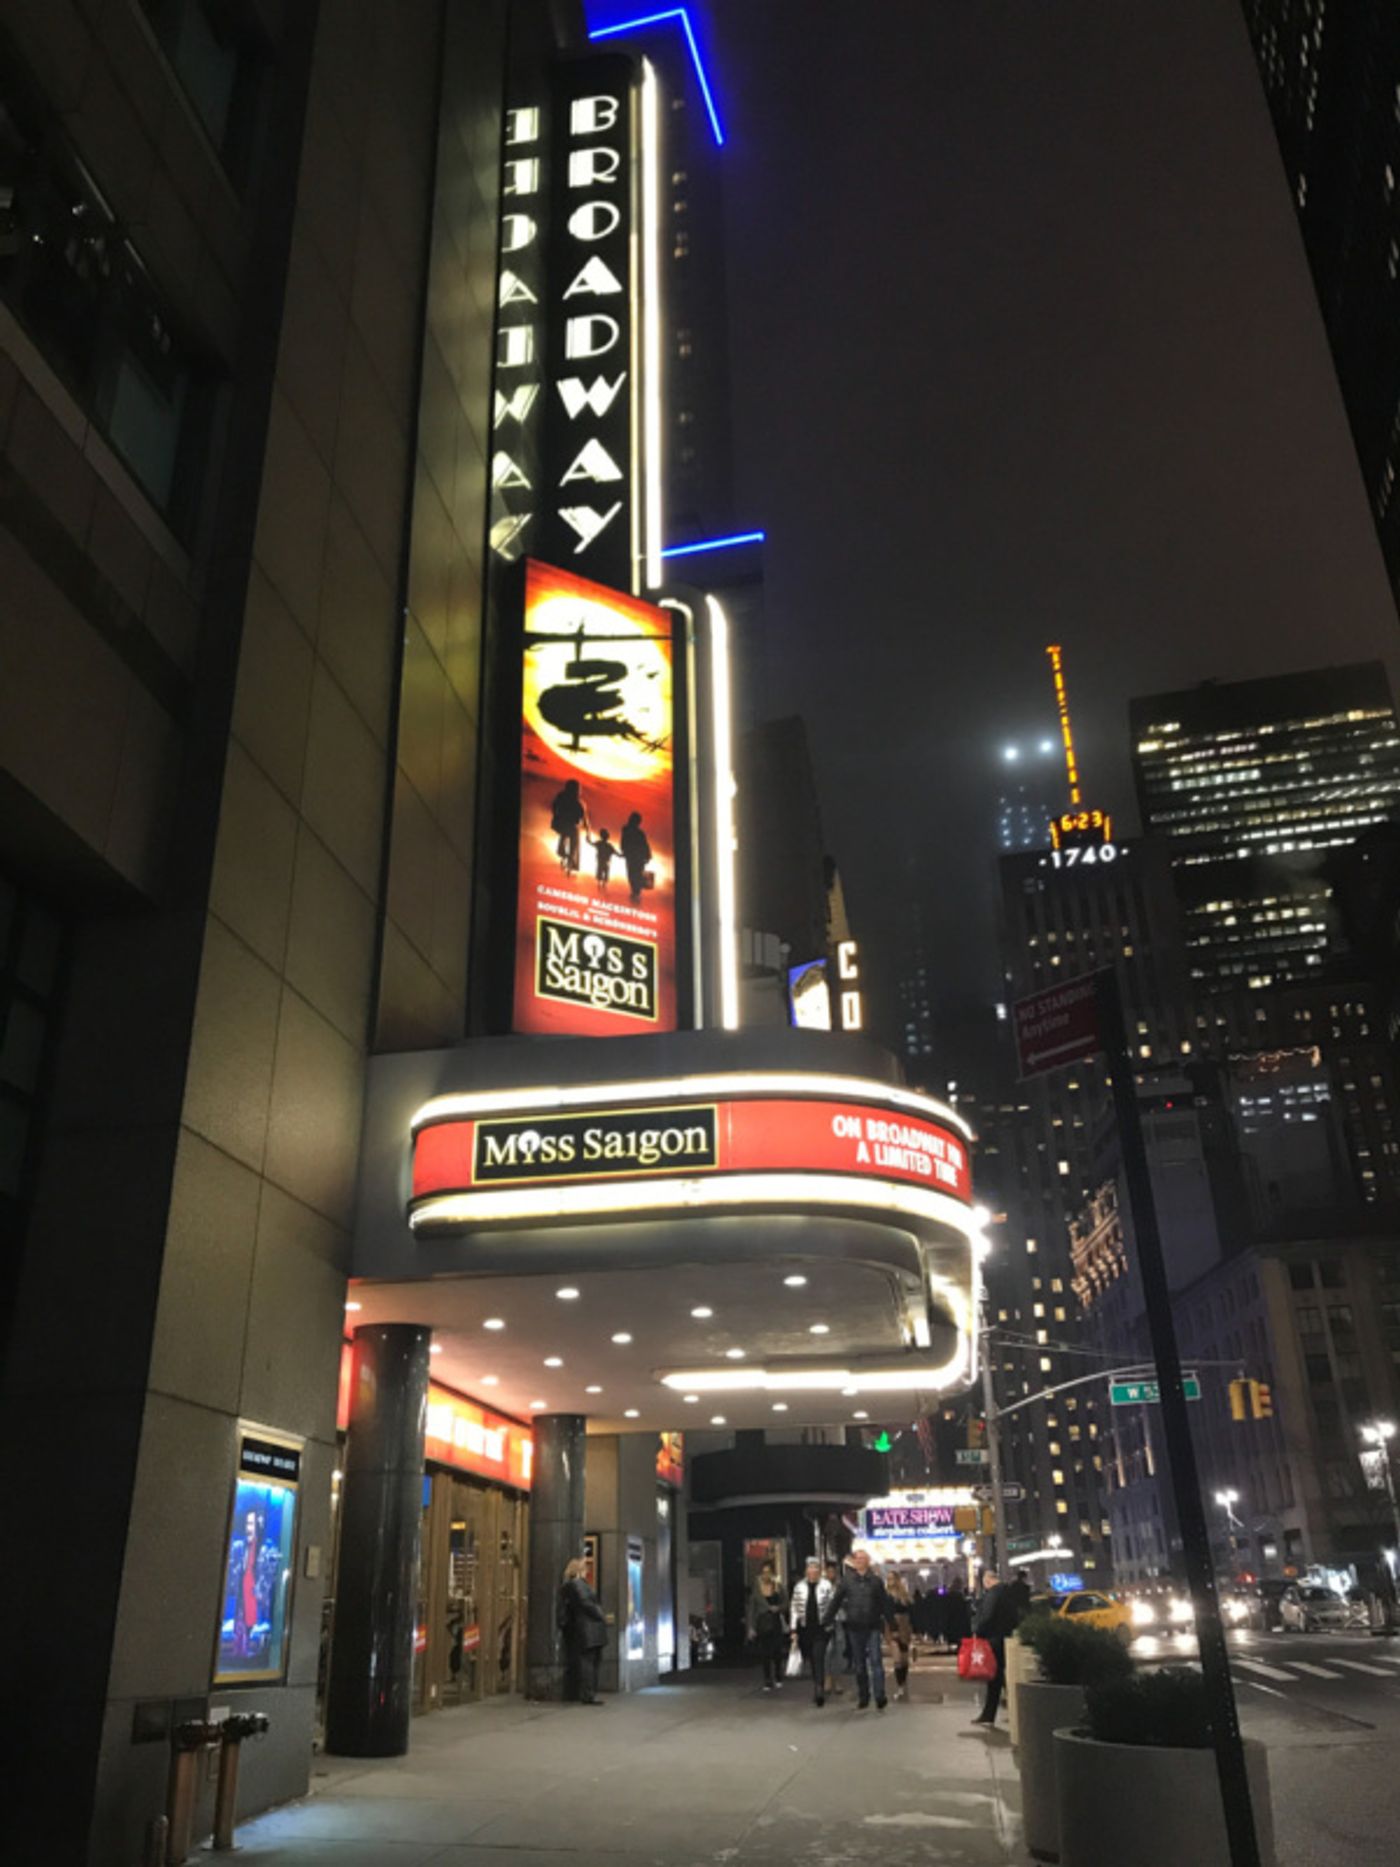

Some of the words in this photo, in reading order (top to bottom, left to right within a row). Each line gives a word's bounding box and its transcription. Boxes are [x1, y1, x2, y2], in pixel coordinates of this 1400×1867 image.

[557, 95, 627, 554] BROADWAY
[1051, 843, 1116, 869] 1740
[546, 952, 650, 1009] Saigon
[480, 1130, 575, 1167] Miss
[582, 1125, 708, 1165] Saigon
[832, 1114, 862, 1139] ON
[865, 1118, 945, 1159] BROADWAY
[856, 1140, 871, 1164] A
[873, 1143, 932, 1176] LIMITED
[872, 1510, 908, 1526] LATE
[910, 1507, 953, 1525] SHOW
